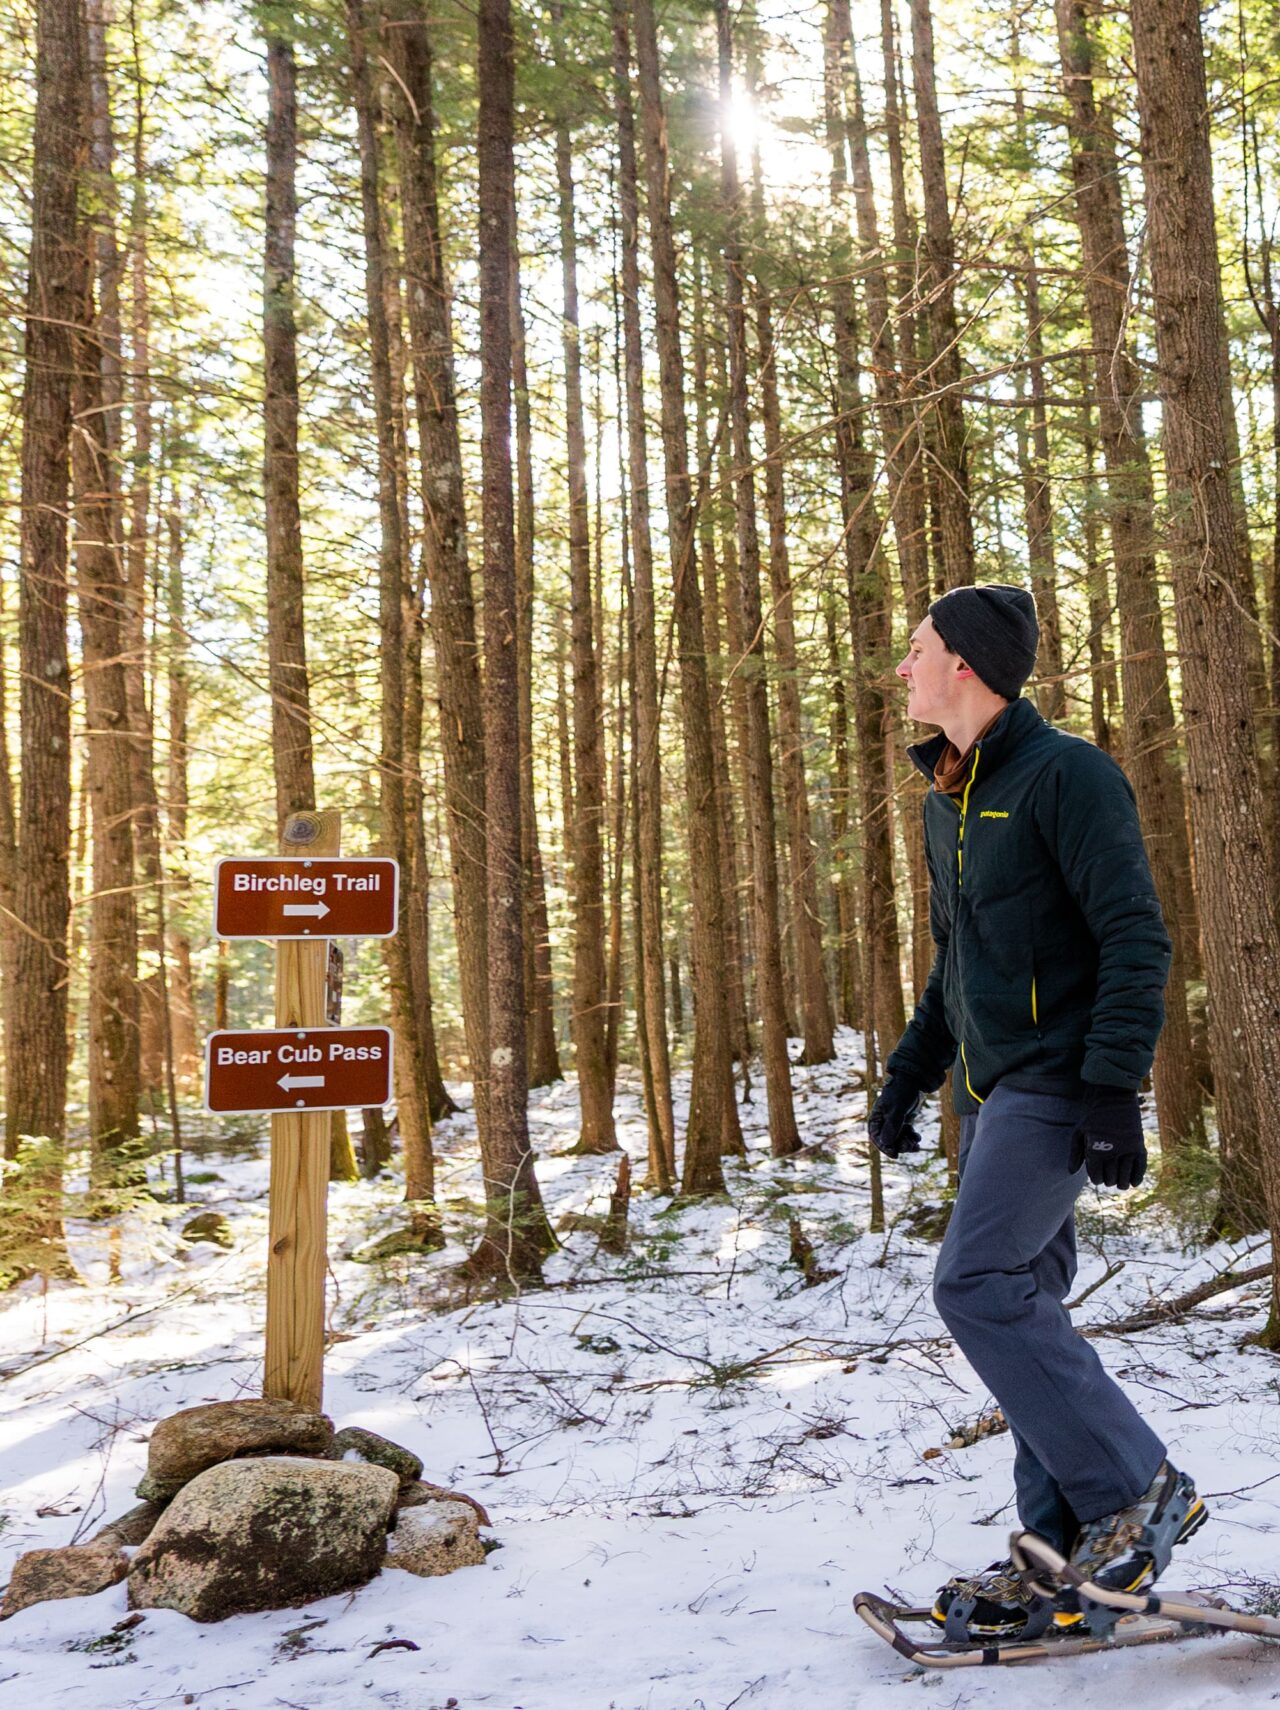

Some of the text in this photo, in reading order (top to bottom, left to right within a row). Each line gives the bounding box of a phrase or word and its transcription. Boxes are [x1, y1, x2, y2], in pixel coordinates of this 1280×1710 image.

[234, 874, 380, 896] Birchleg Trail
[217, 1043, 382, 1066] Bear Cub Pass
